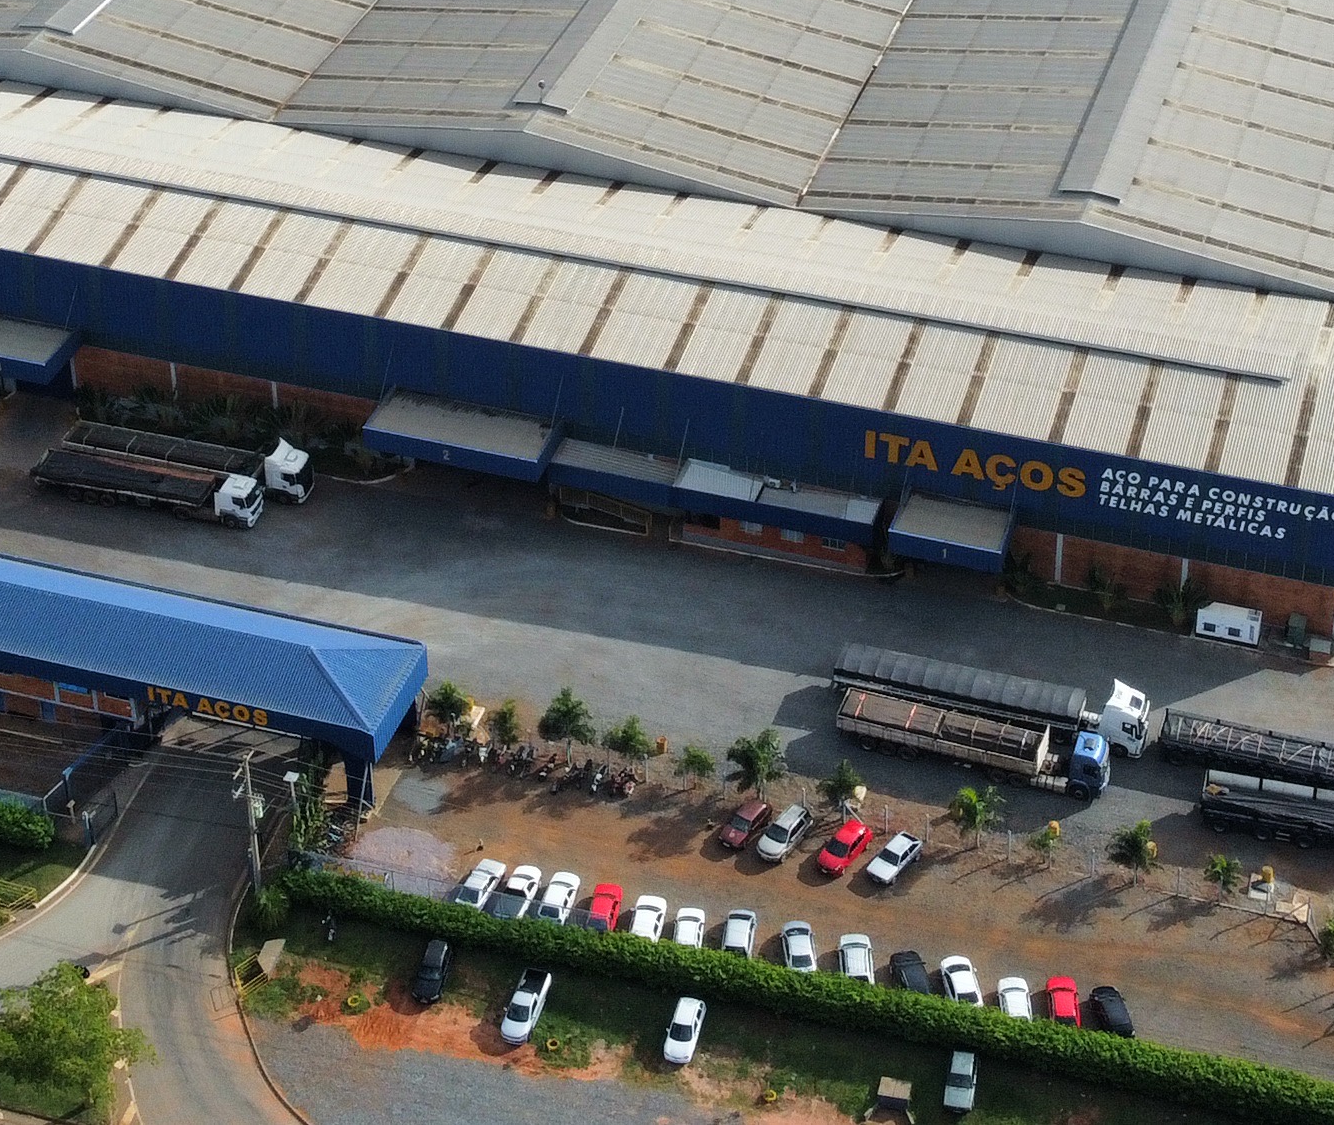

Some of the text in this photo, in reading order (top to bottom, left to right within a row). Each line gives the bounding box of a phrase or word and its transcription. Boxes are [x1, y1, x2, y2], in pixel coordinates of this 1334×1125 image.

[864, 430, 1087, 498] ITA AÇOS
[1101, 468, 1141, 485] AÇO
[1148, 476, 1200, 497] PARA
[1099, 494, 1286, 540] TELHAS METÁLICAS
[1100, 481, 1267, 522] BARRAS E PERFIS
[147, 686, 189, 709] ITA
